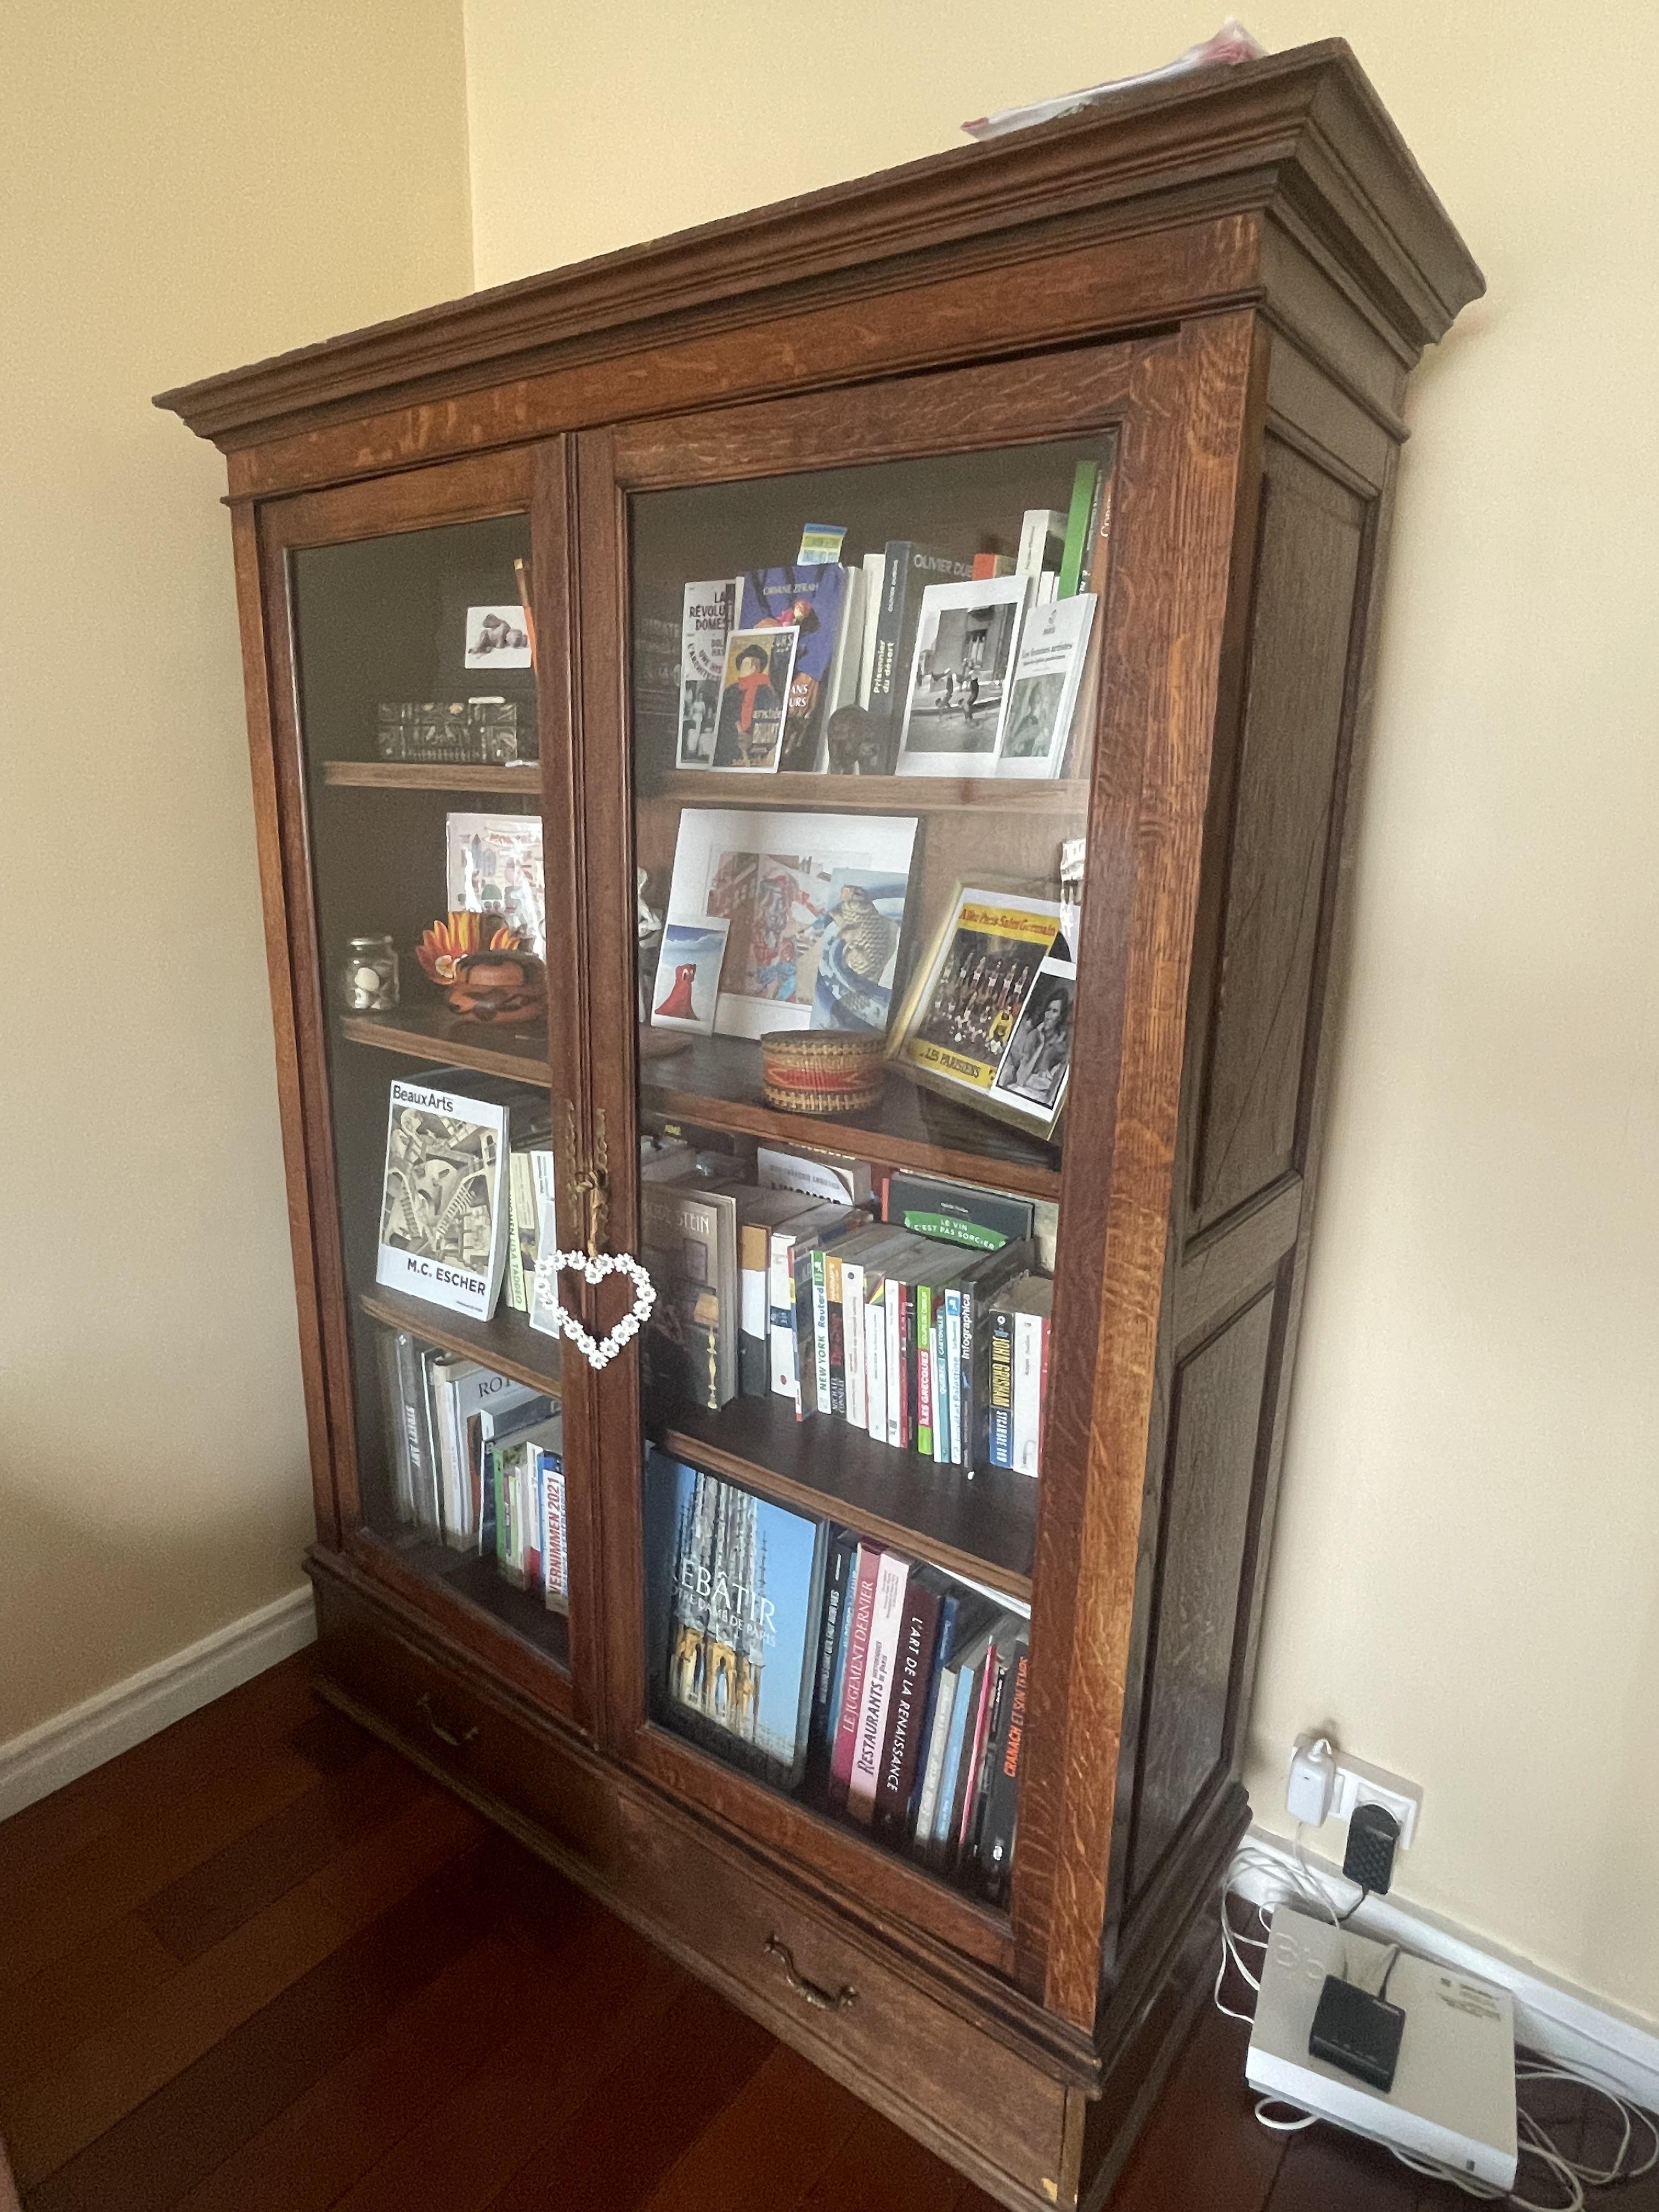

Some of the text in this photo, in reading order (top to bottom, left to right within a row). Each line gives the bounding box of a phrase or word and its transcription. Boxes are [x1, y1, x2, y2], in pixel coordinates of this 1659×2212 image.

[393, 1084, 454, 1113] BeauxArts
[939, 1226, 955, 1236] PAS
[940, 1218, 968, 1232] LE VIN
[407, 1257, 486, 1296] M.C. ESCHER
[817, 1287, 828, 1391] NEW YORK Routard
[920, 1351, 928, 1403] GRECQUES
[992, 1335, 1011, 1408] JOHN GRISHAM
[547, 1476, 560, 1512] 2021
[674, 1557, 777, 1634] EBÂTIR
[855, 1581, 874, 1643] DERNIER
[887, 1617, 923, 1793] L'ART DE LA RENAISSANCE
[1003, 1725, 1022, 1778] CRANACH
